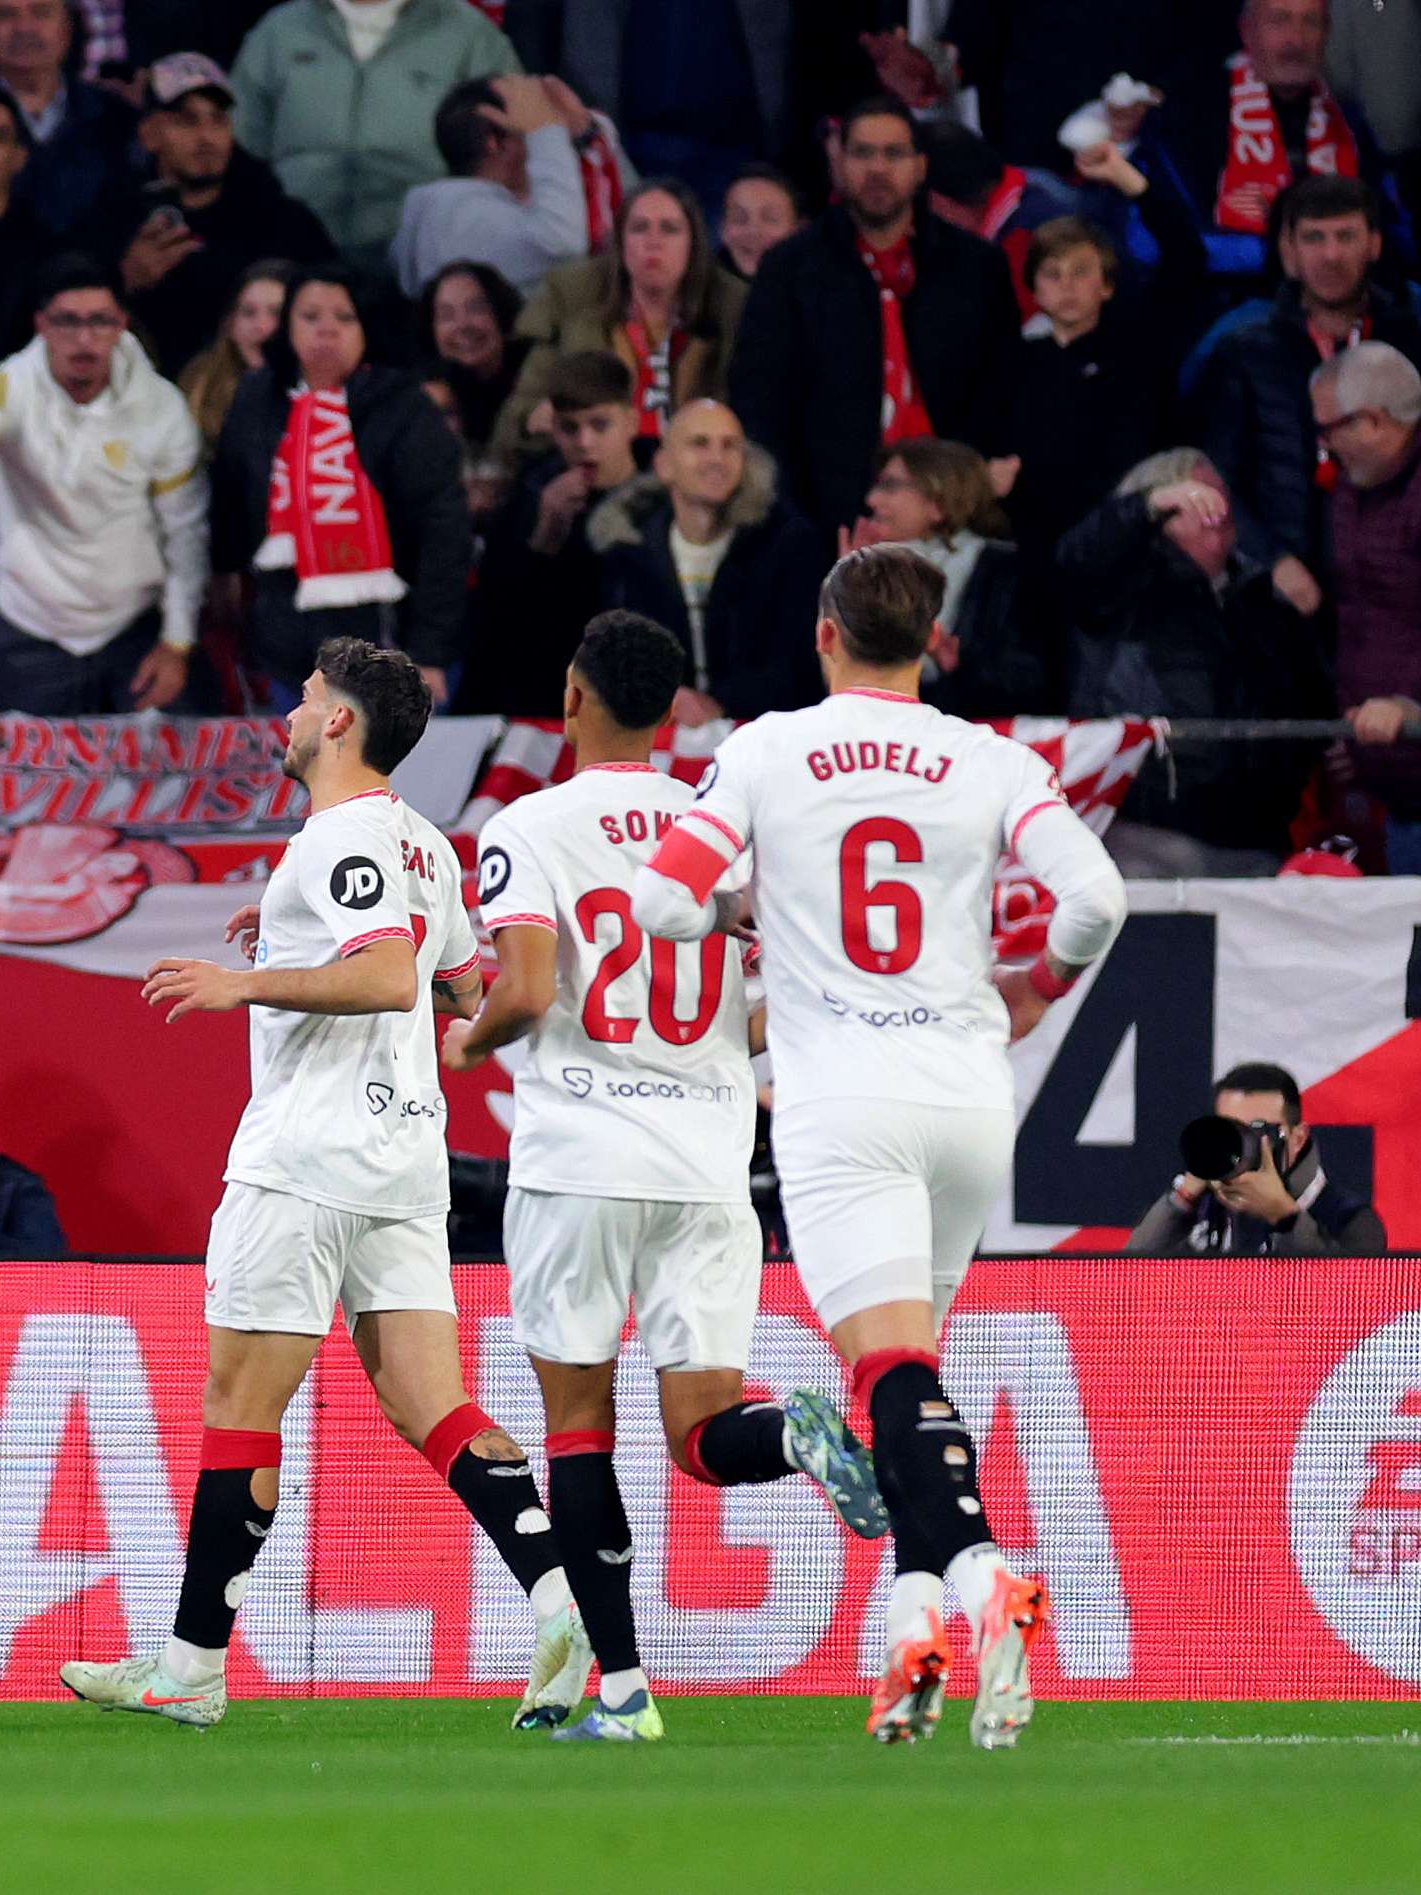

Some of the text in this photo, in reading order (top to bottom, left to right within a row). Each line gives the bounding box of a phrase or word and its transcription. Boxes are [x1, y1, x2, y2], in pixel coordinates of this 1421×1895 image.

[807, 742, 953, 784] GUDELJ
[340, 866, 379, 904] JD
[840, 816, 924, 976] 6
[575, 886, 728, 1046] 20
